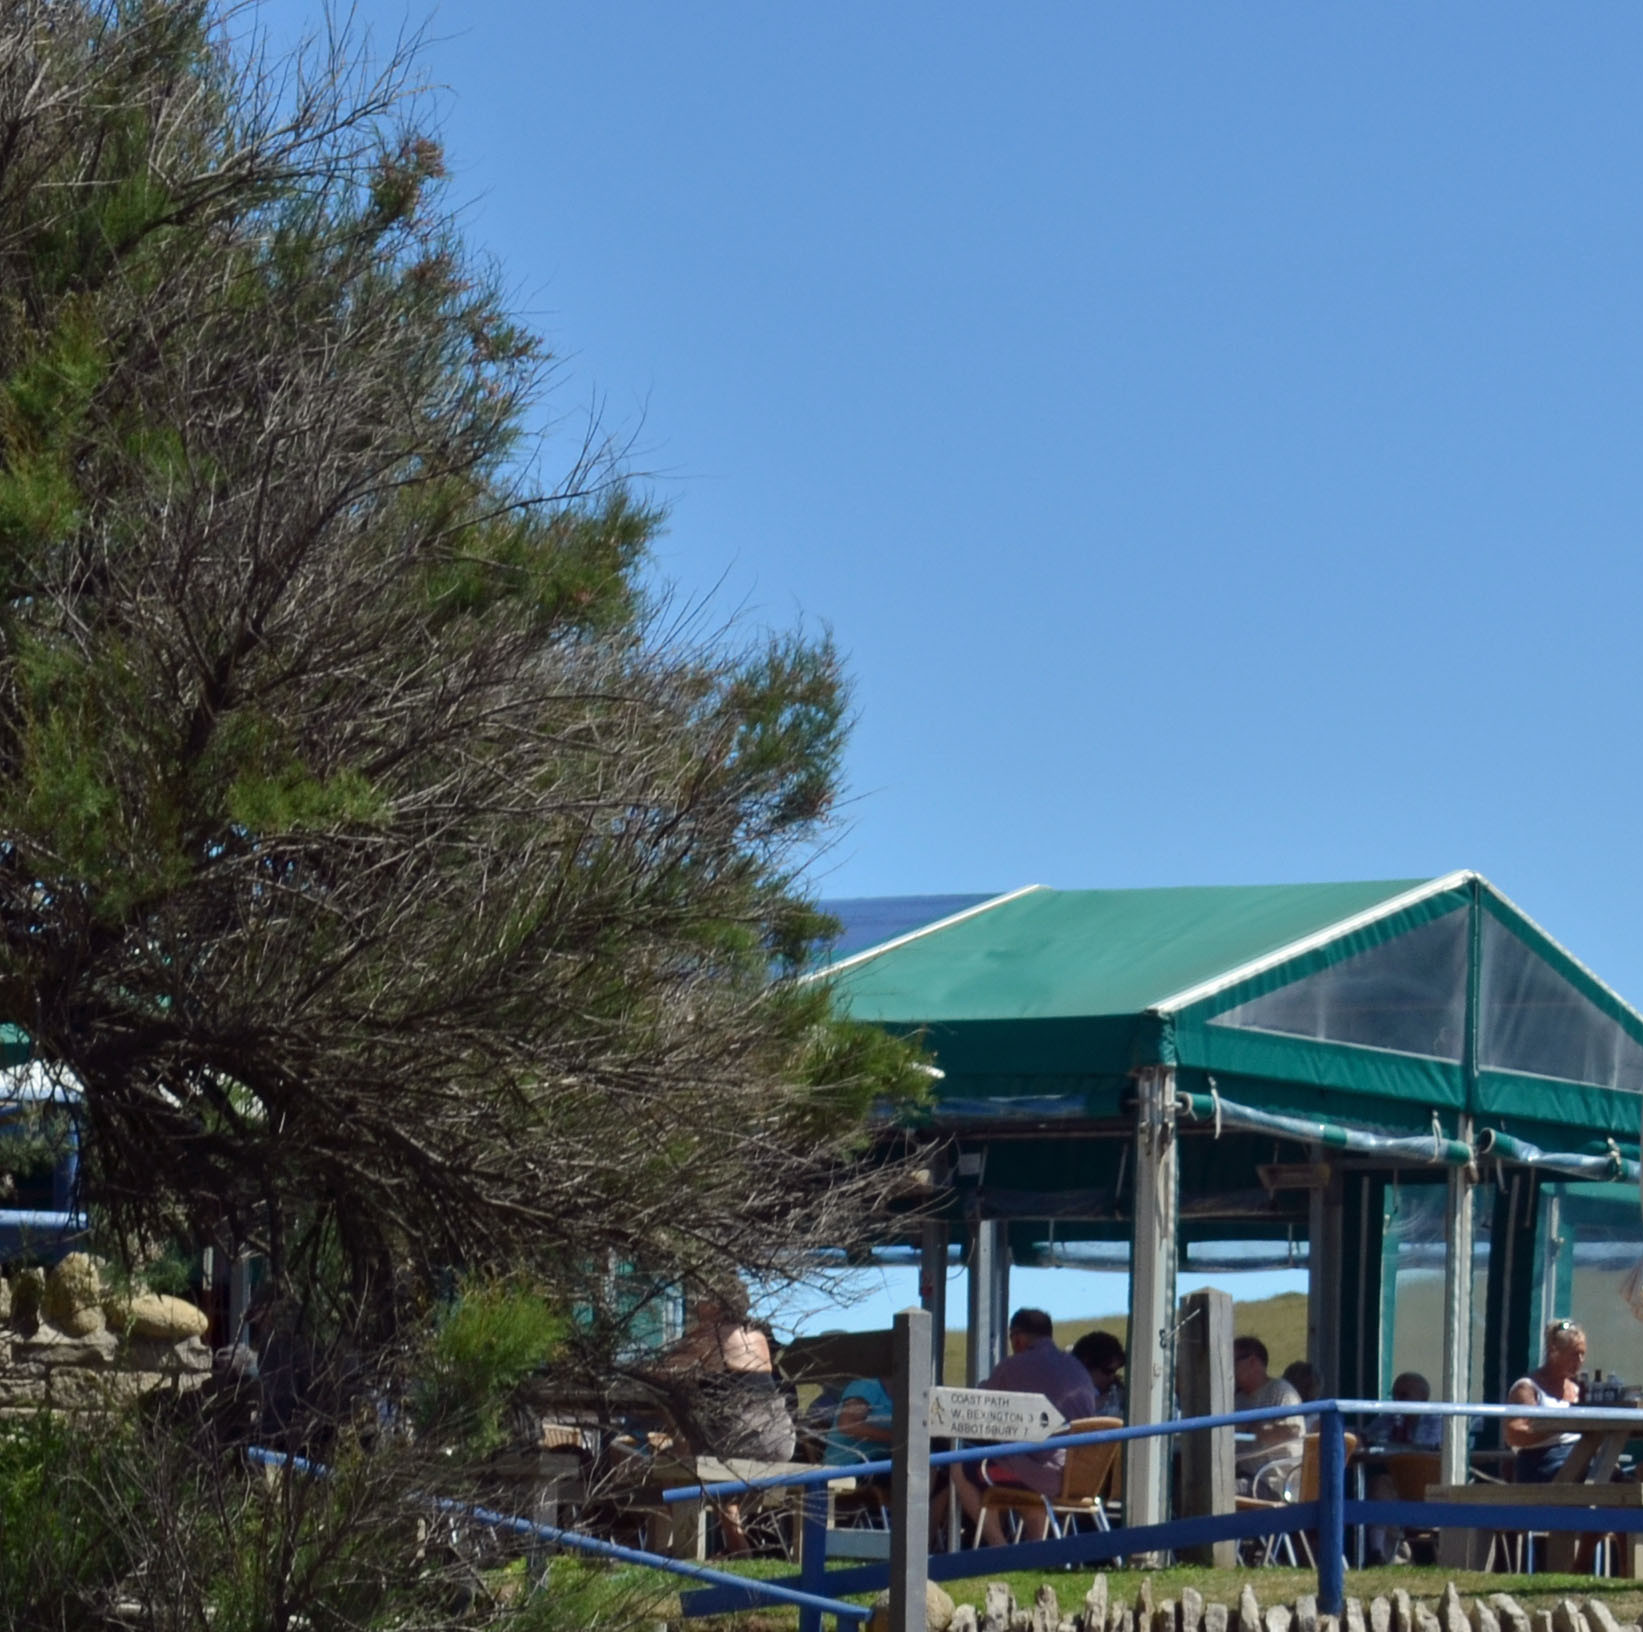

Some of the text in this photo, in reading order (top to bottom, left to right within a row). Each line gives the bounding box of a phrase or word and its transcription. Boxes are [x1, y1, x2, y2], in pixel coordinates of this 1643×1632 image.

[951, 1393, 1010, 1408] COAST PATH
[966, 1409, 1024, 1423] BEXINGTON
[951, 1421, 1018, 1437] ABBOTSBURY
